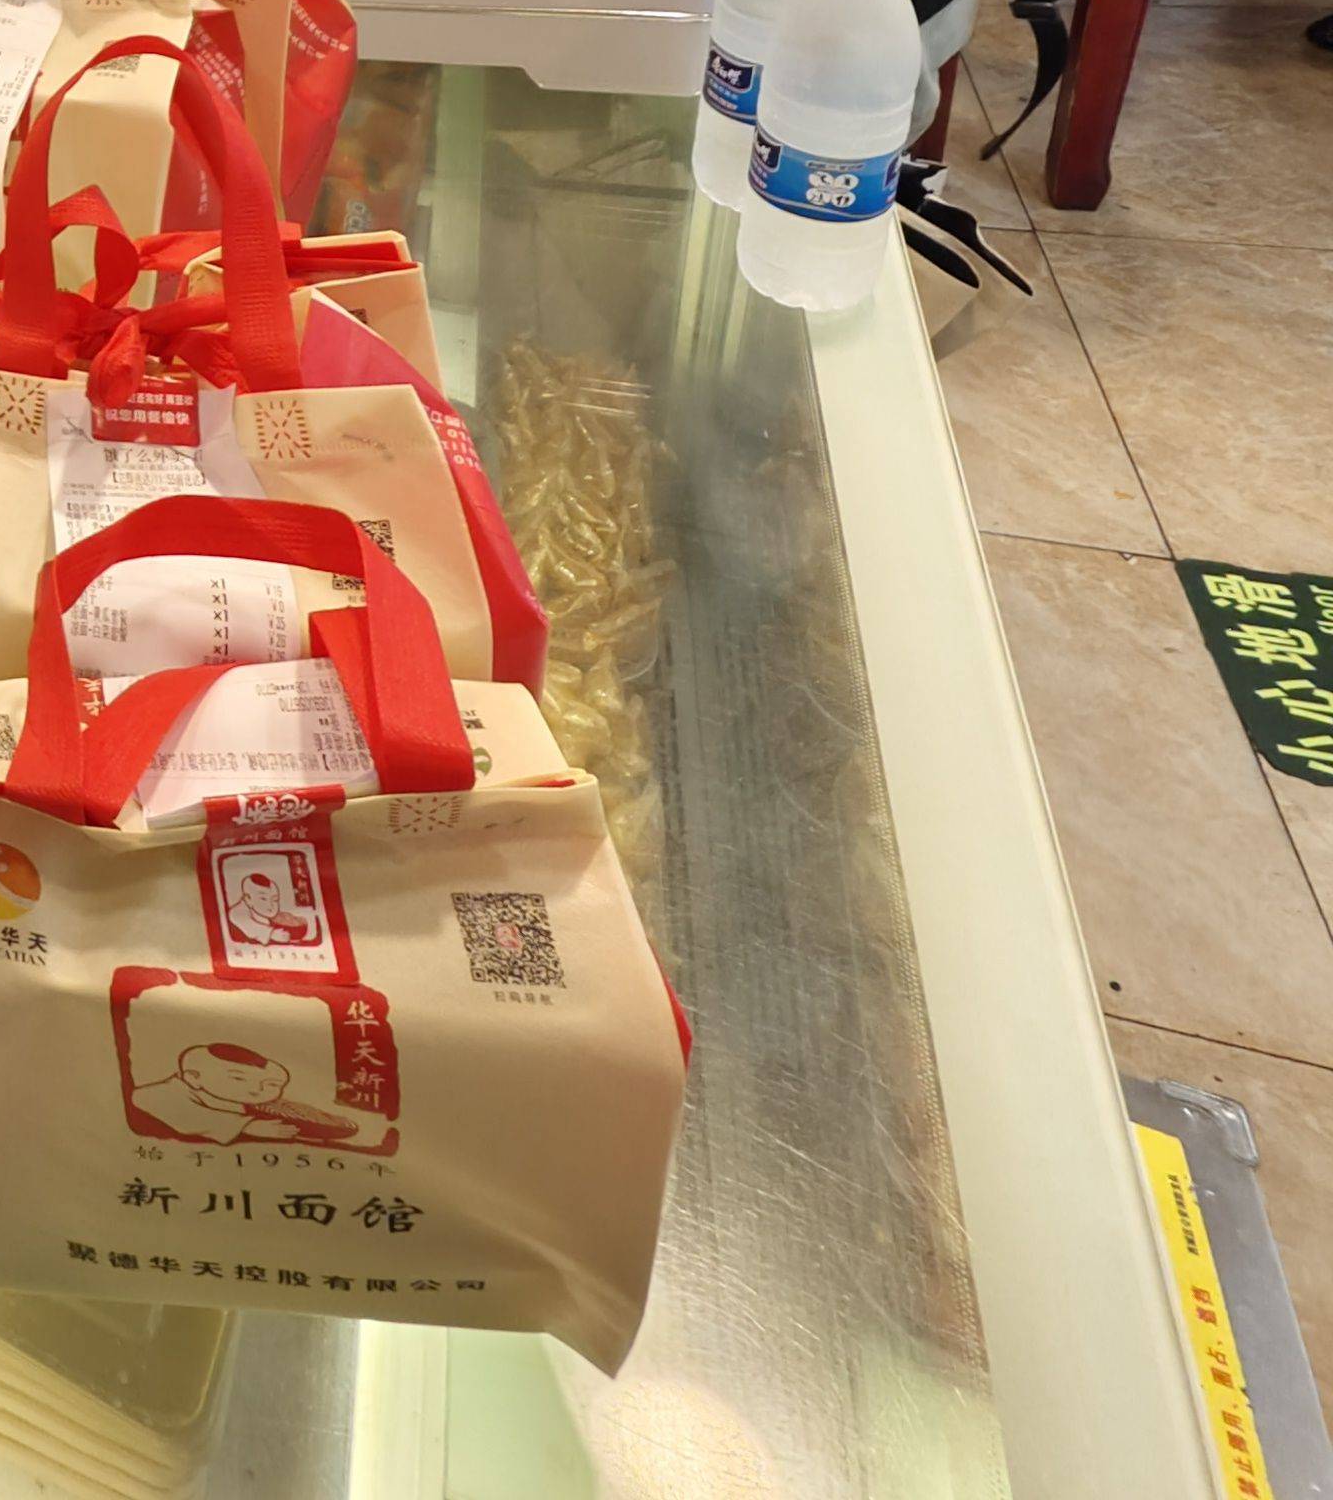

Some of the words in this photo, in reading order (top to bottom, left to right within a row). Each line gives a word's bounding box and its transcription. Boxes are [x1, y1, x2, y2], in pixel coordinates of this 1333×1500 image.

[104, 408, 191, 425] 祝您用餐愉快
[343, 999, 386, 1109] 华天新川
[133, 1145, 397, 1179] 始于1956年
[117, 1175, 425, 1235] 新川面馆
[66, 1237, 487, 1294] 聚德华天控股有限公司
